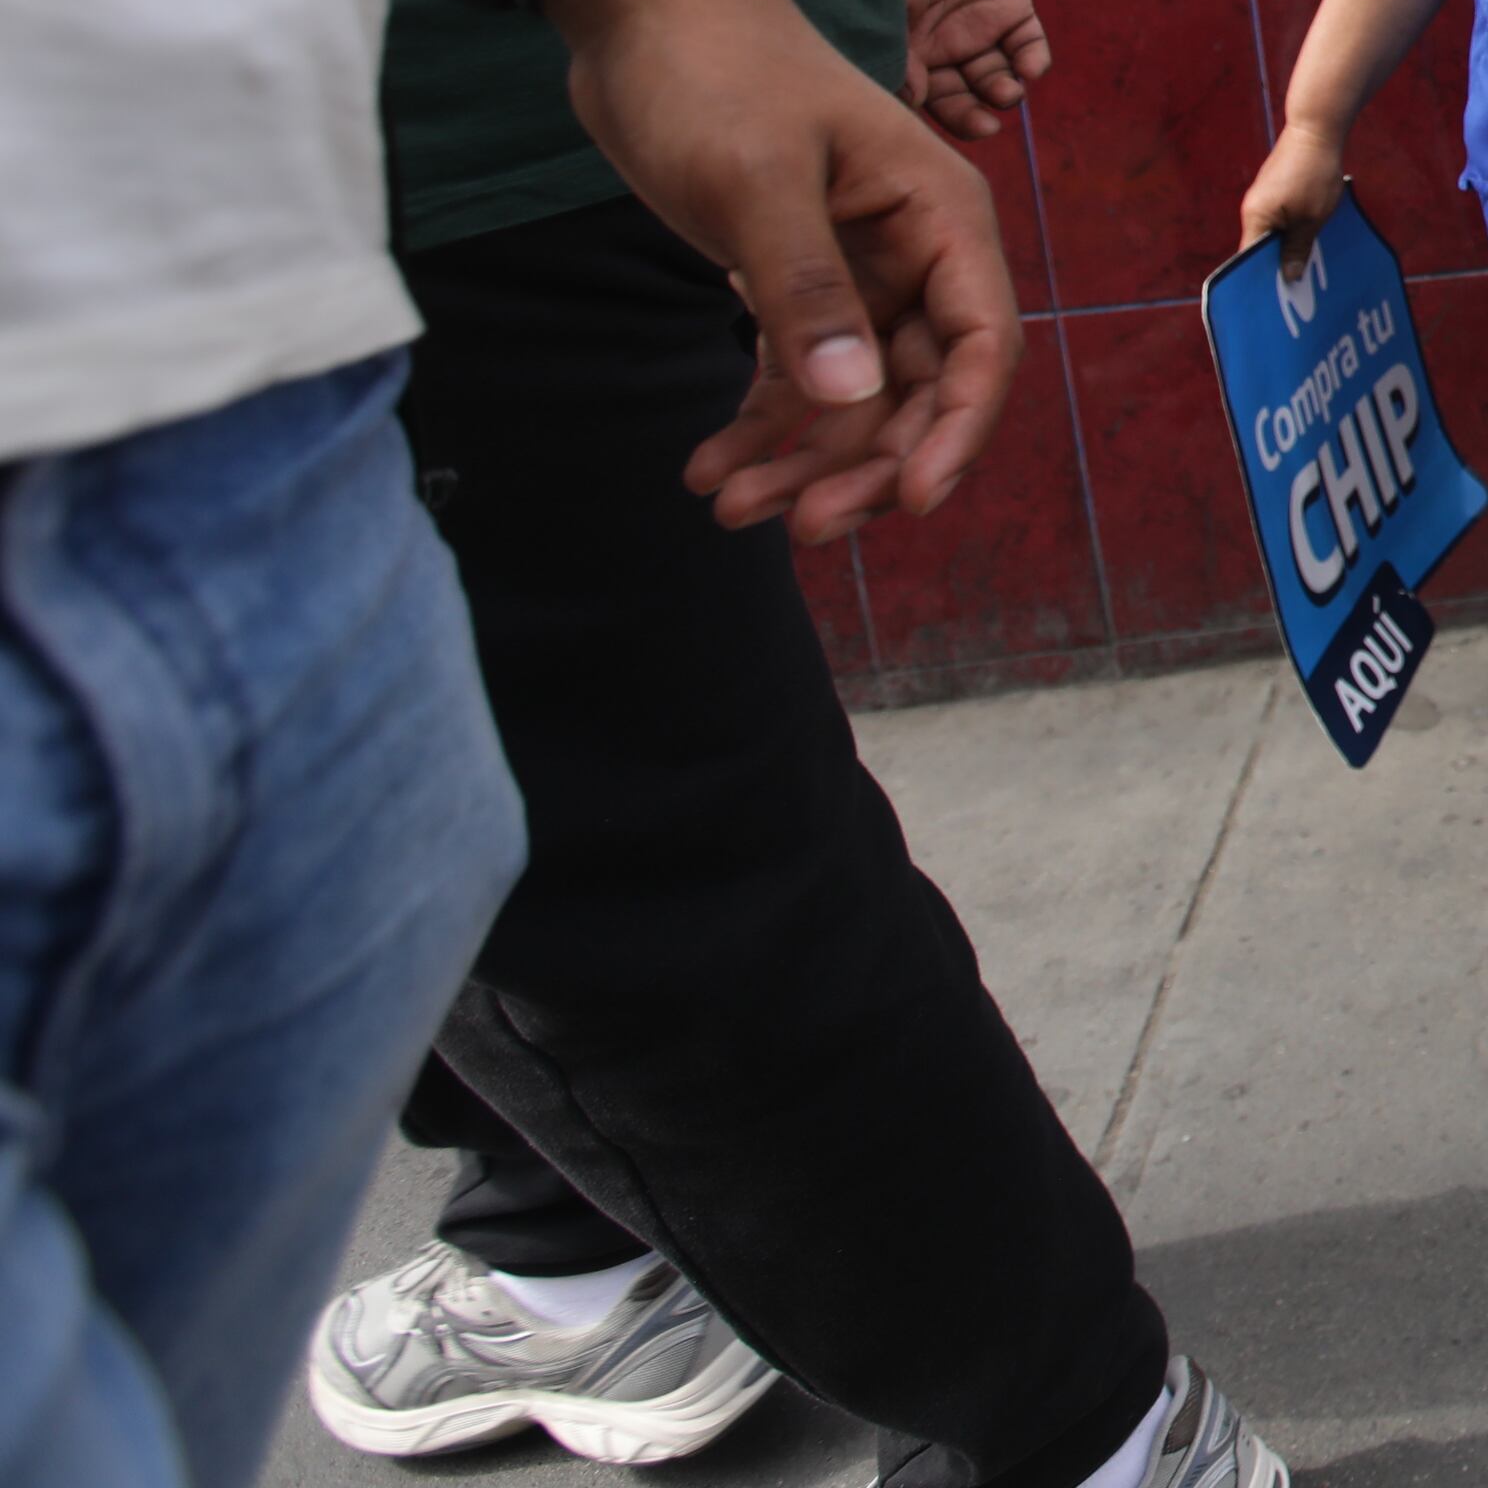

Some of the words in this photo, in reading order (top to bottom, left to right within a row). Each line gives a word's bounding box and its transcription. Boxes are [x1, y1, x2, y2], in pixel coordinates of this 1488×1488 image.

[1255, 333, 1360, 472] Compra
[1357, 299, 1396, 356] tu
[1288, 363, 1419, 595] CHIP
[1334, 593, 1414, 734] AQUÍ
